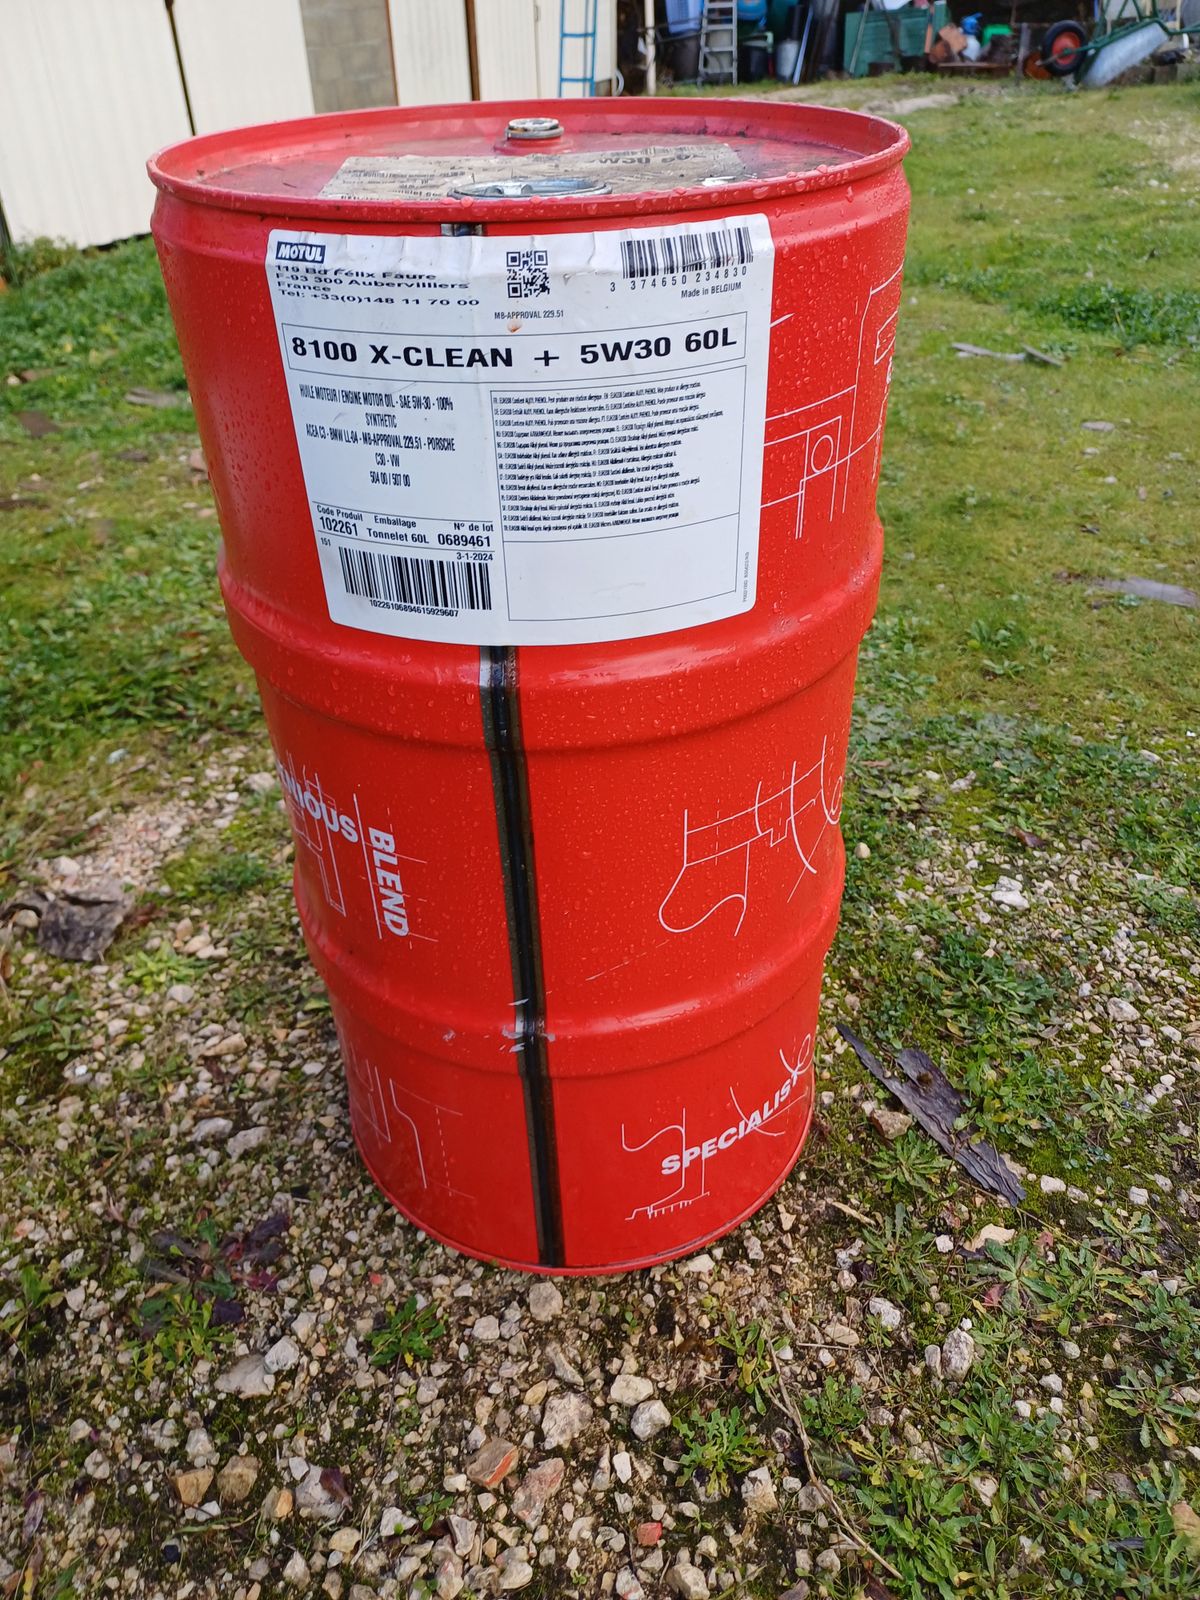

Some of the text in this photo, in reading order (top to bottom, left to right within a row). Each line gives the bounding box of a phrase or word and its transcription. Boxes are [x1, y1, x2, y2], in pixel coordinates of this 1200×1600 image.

[277, 243, 325, 263] MOTUL
[275, 272, 308, 282] F-93
[313, 276, 343, 285] 300
[305, 266, 328, 275] Bd
[382, 271, 437, 280] Faure
[630, 275, 688, 291] 374650
[695, 265, 748, 283] 234830
[277, 281, 331, 292] France
[681, 281, 742, 298] Made in BELGIUM
[429, 298, 450, 306] 70
[494, 310, 542, 319] MB-APPROVAL
[291, 327, 737, 368] 8100 X-CLEAN + 5W30 60L
[315, 386, 338, 402] MOTEUR
[341, 390, 362, 405] ENGINE
[362, 392, 384, 407] MOTOR
[384, 393, 396, 408] OIL
[399, 395, 412, 409] SAE
[412, 395, 431, 410] 5W-30
[365, 412, 398, 428] SYNTHETIC
[318, 426, 326, 439] C3
[330, 427, 344, 442] BMW
[362, 431, 403, 449] MB-APPROVAL
[403, 435, 422, 450] 229.51
[427, 436, 455, 451] PORSCHE
[317, 504, 364, 522] Code Produit
[374, 515, 417, 528] Emballage
[468, 523, 481, 532] de
[482, 523, 494, 532] lot
[319, 516, 491, 548] 102261 Tonnelet 60L 0689461
[320, 537, 331, 547] 151
[456, 551, 494, 562] 3-1-2024
[368, 826, 410, 937] BLEND
